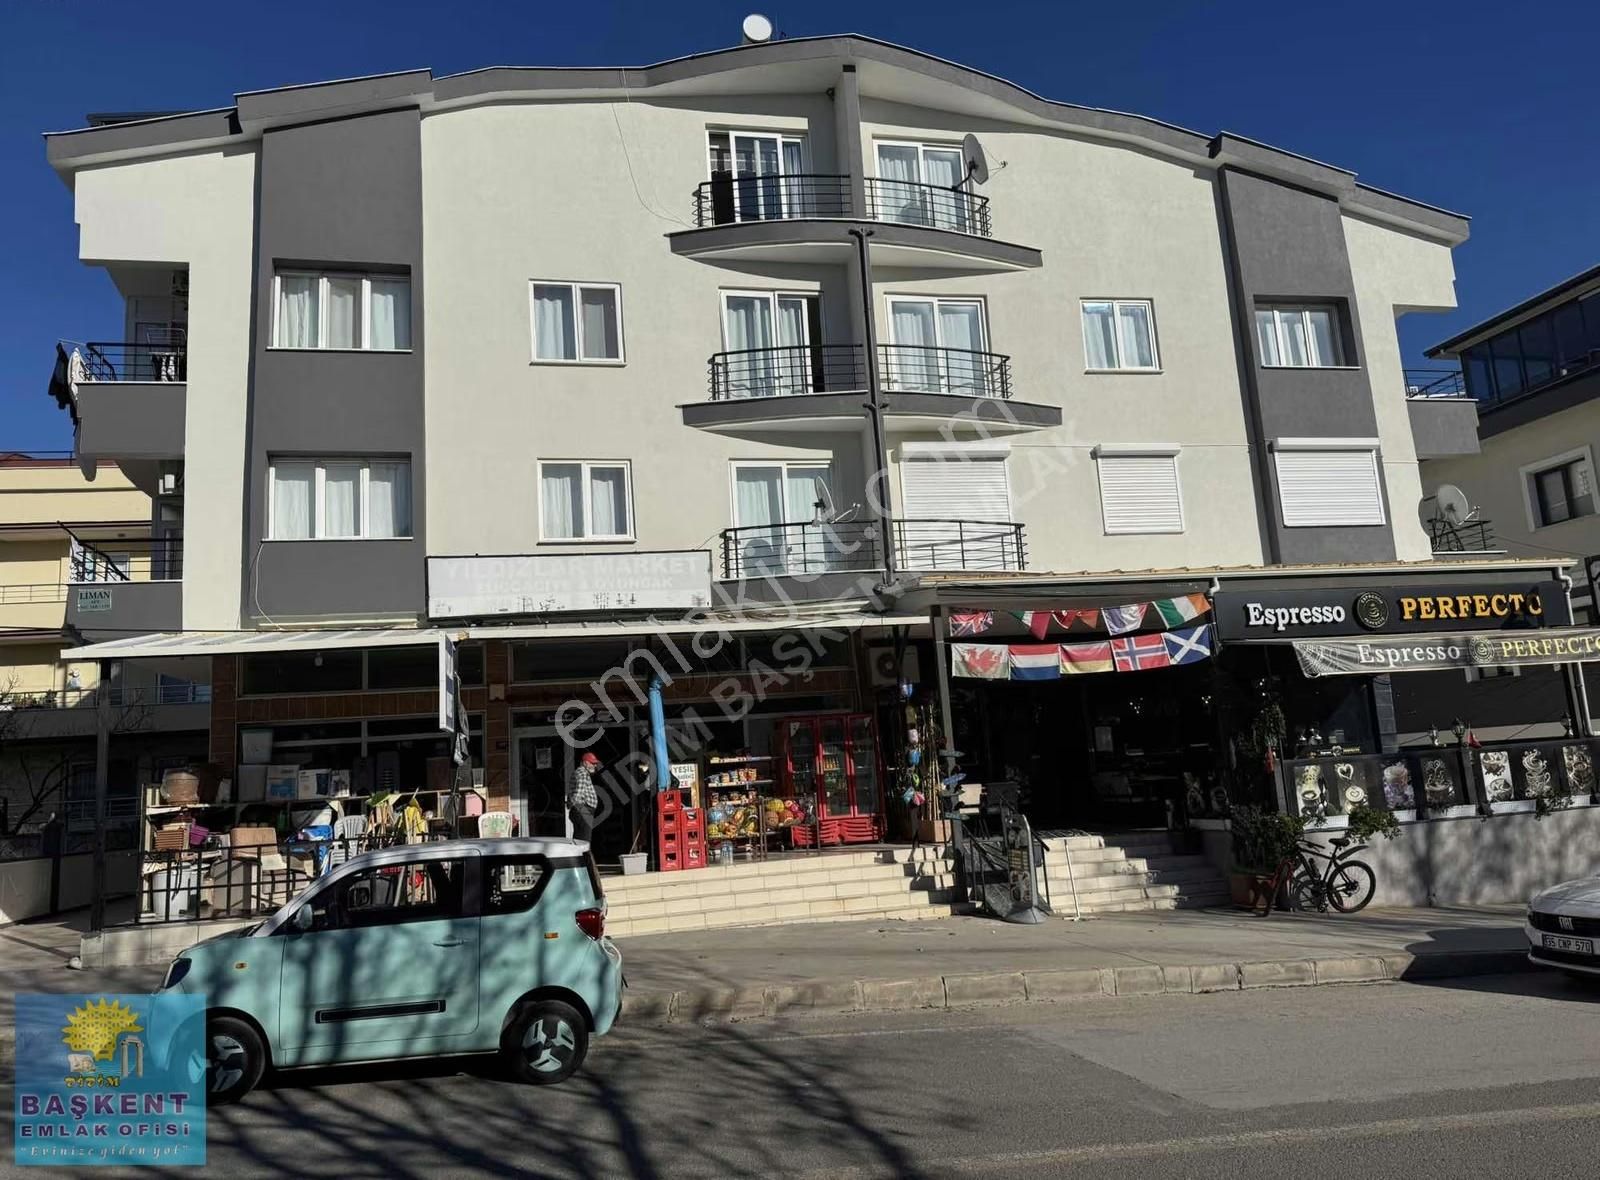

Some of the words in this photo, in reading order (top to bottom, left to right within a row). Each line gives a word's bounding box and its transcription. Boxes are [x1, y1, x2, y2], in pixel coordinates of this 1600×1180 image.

[592, 555, 699, 574] MARKET
[1247, 603, 1346, 631] Espresso
[1401, 594, 1543, 620] PERFECTO
[1357, 644, 1460, 668] Espresso
